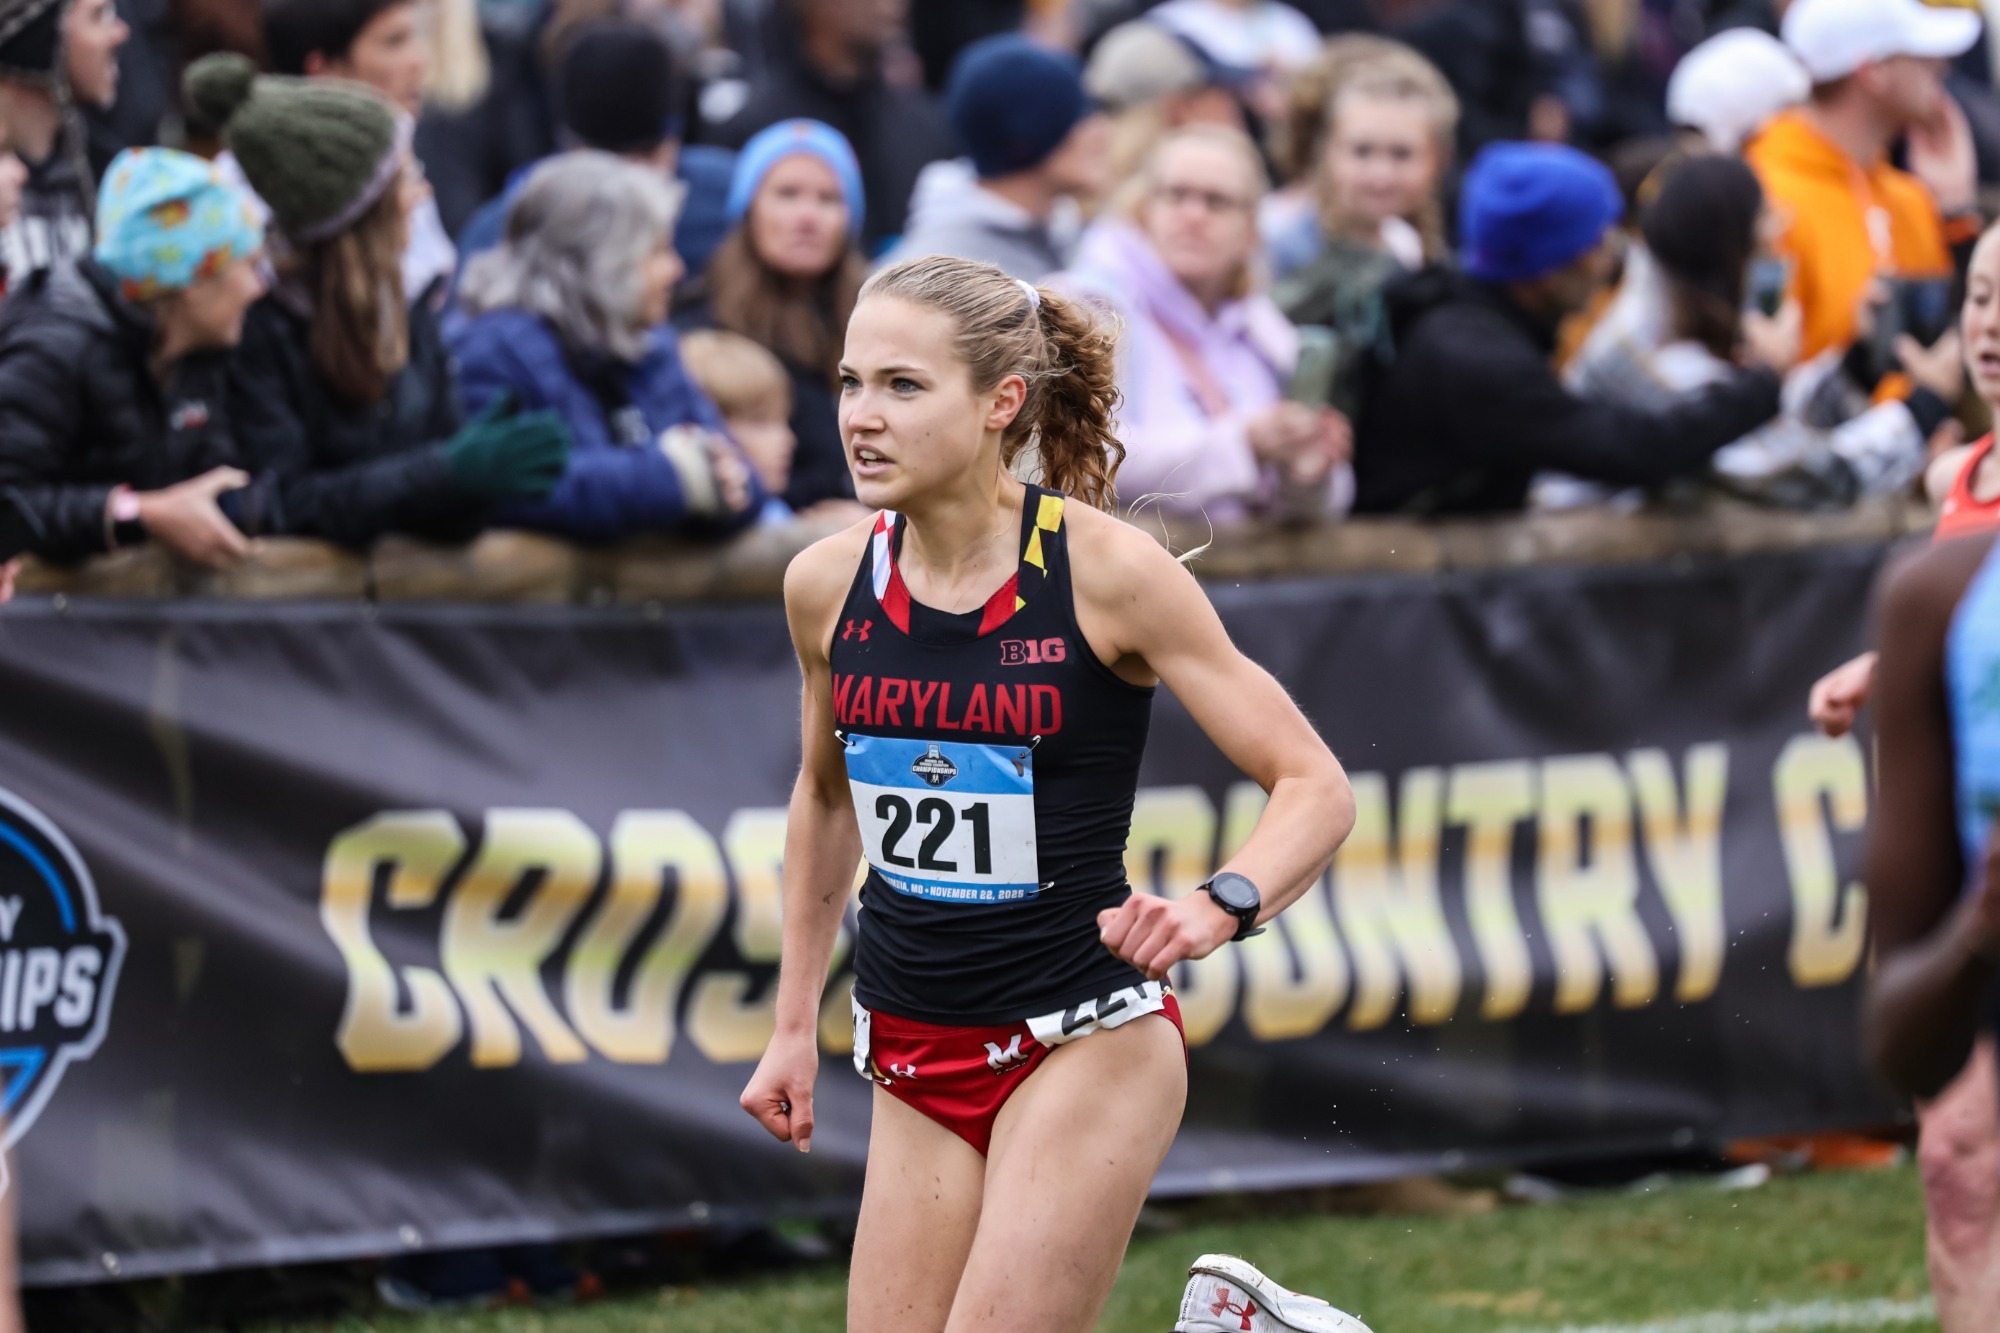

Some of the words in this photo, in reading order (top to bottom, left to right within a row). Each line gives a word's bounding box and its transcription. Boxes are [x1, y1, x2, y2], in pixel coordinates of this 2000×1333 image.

[833, 674, 1063, 736] MARYLAND
[912, 765, 957, 775] CHAMPIONSHIPS
[875, 794, 992, 874] 221
[911, 883, 924, 895] MO
[930, 886, 978, 899] NOVEMBER
[998, 889, 1024, 900] 2025
[0, 944, 102, 1032] IPS
